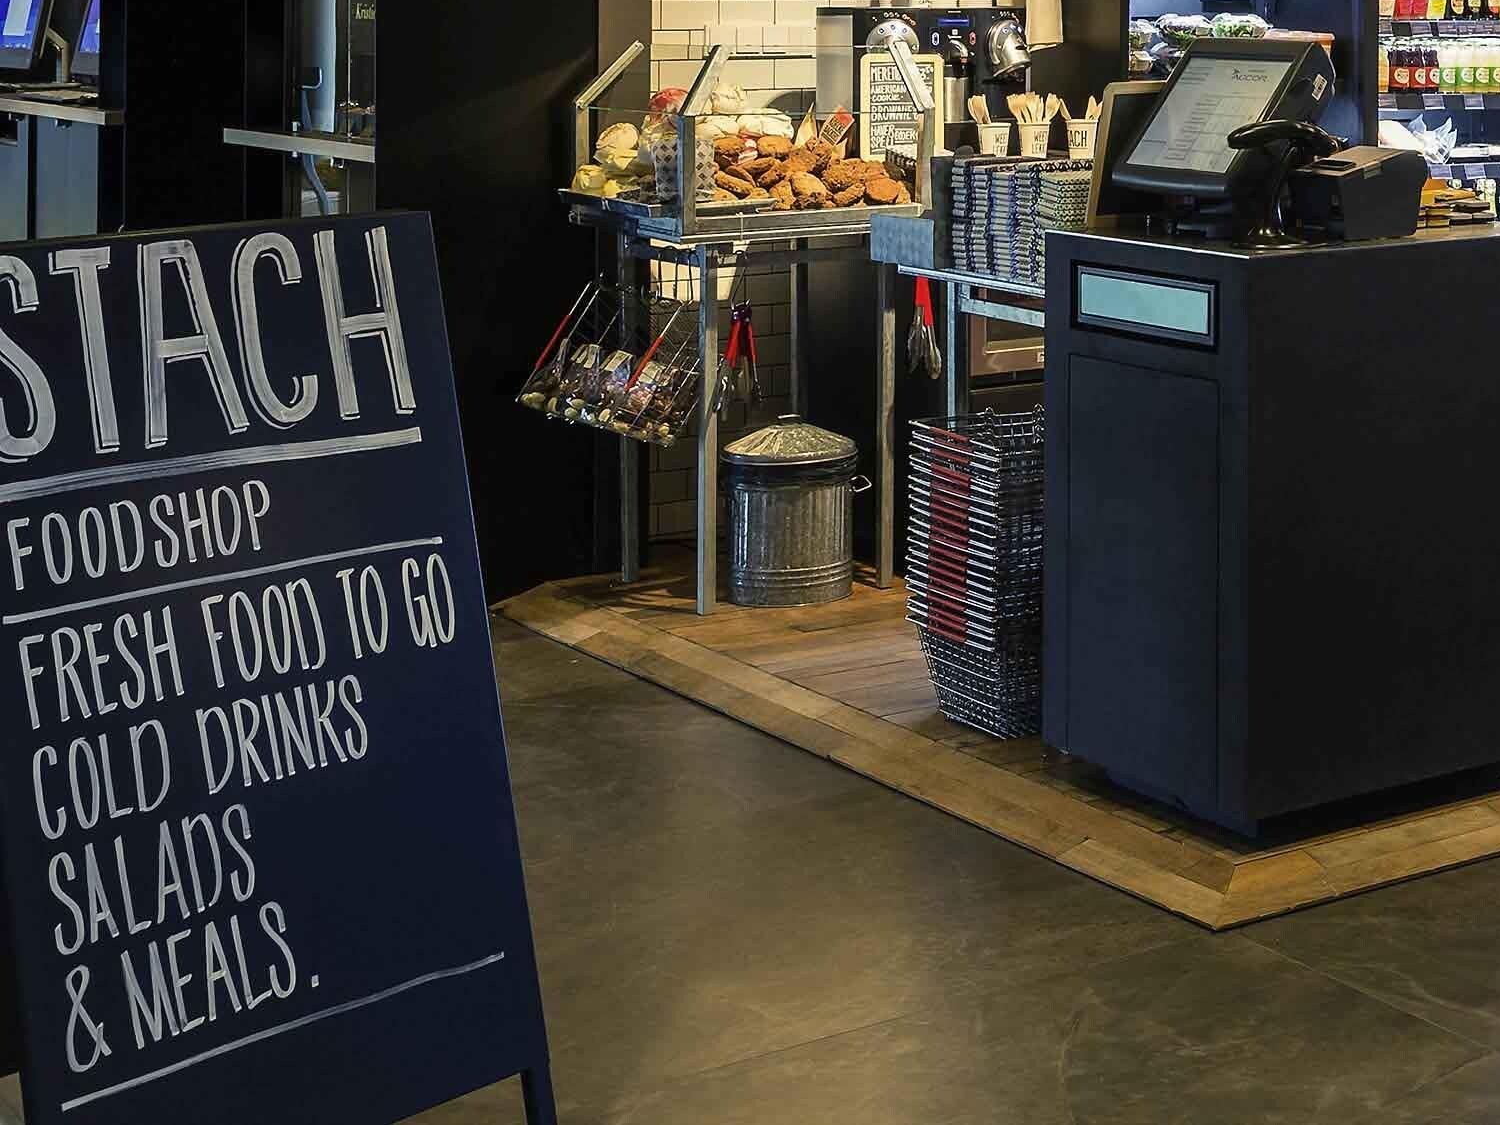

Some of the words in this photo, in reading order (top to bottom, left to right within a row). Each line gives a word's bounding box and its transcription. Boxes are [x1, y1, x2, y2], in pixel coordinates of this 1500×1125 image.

[7, 479, 272, 592] FOODSHOP
[17, 608, 185, 731] FRESH
[204, 578, 328, 688] FOOD
[336, 565, 390, 662] TO
[403, 553, 456, 651] GO
[32, 717, 173, 841] COLD
[196, 673, 369, 796] DRINKS
[47, 802, 257, 957] SALADS
[64, 963, 113, 1075] &
